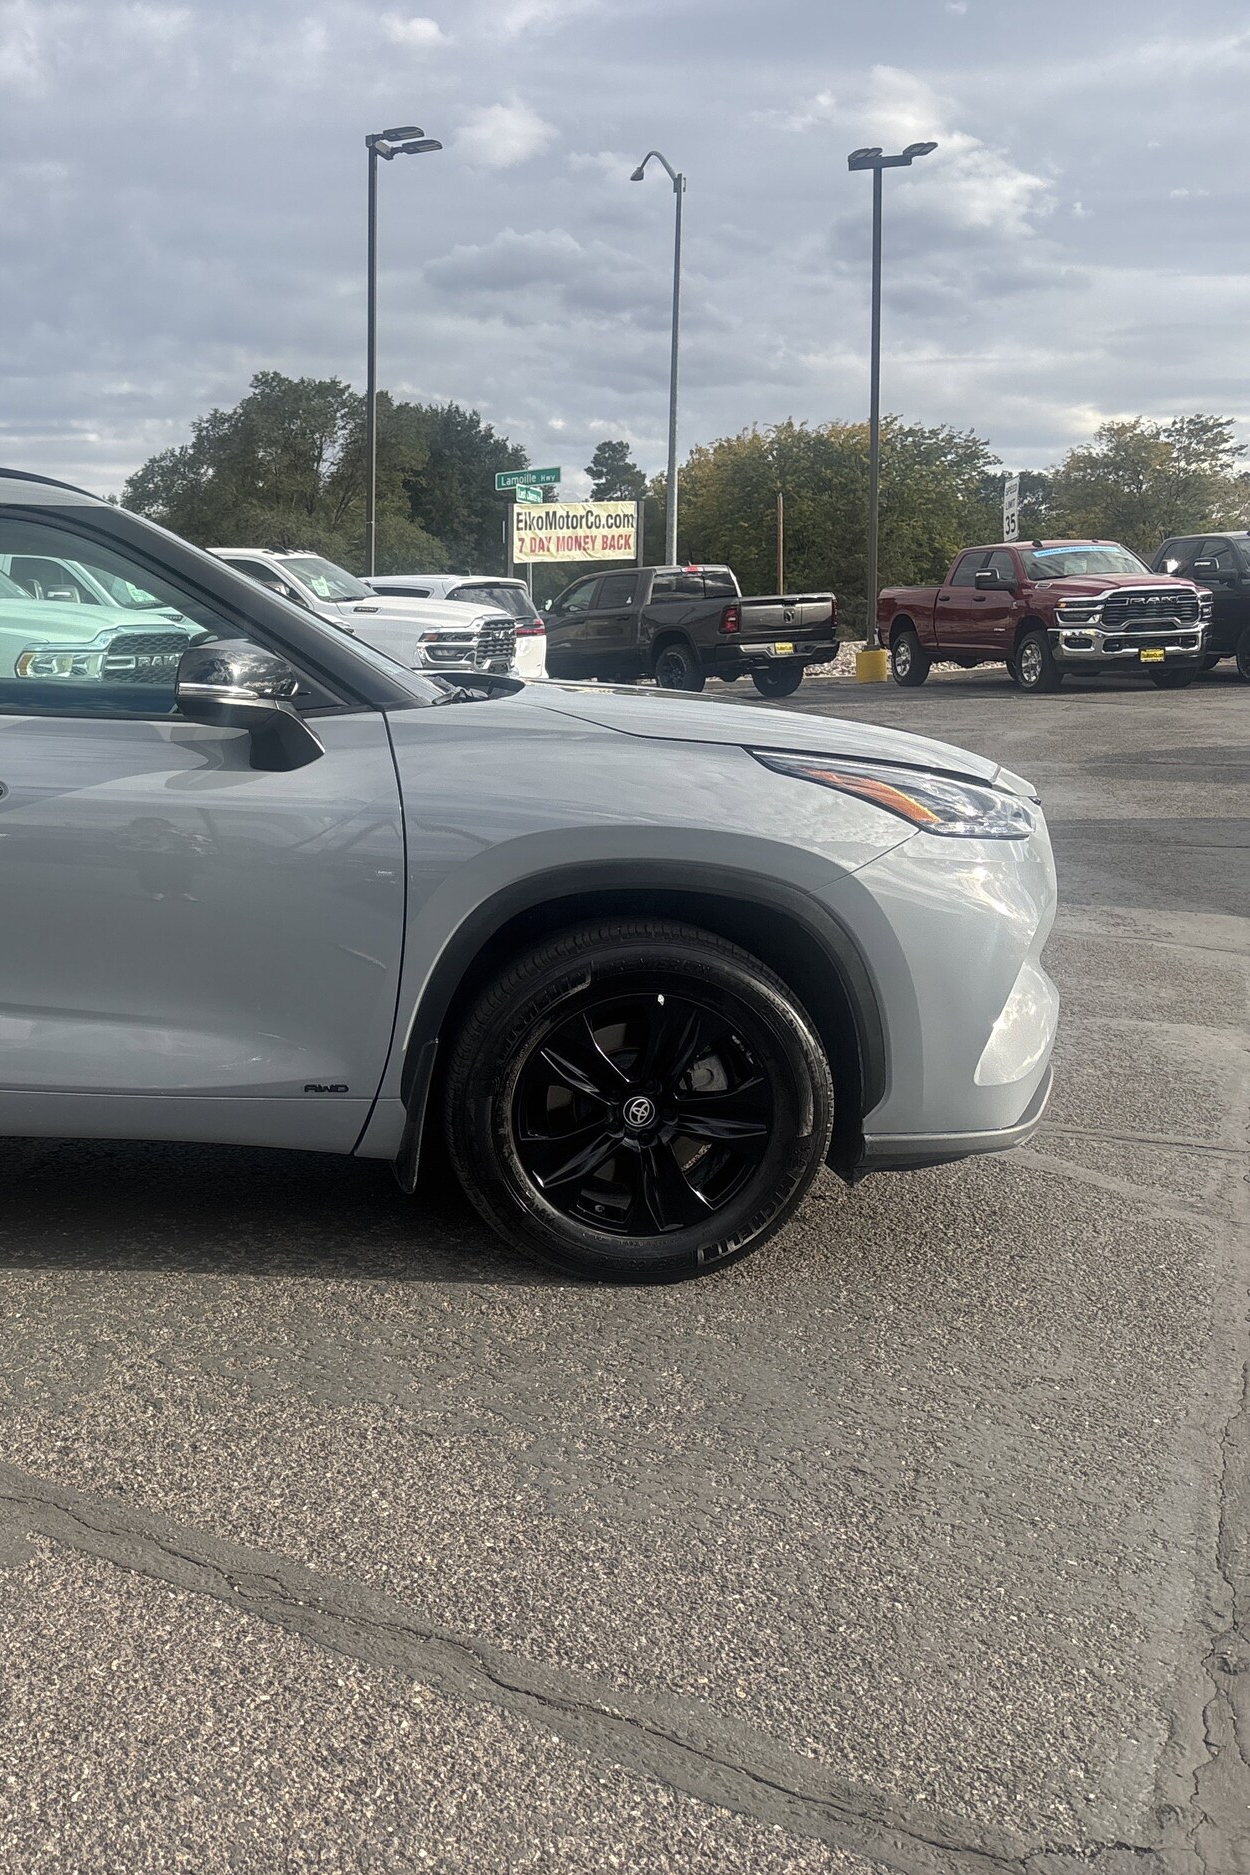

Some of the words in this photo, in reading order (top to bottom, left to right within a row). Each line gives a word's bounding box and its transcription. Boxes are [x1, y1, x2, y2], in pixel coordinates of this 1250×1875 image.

[501, 472, 537, 487] Lamoille
[540, 473, 556, 482] Hwy
[516, 510, 634, 531] ElkoMotorCo.com
[1005, 513, 1016, 535] 35
[518, 537, 525, 554] 7
[529, 536, 552, 553] DAY
[556, 534, 598, 553] MONEY
[601, 533, 632, 550] BACK
[1129, 596, 1177, 605] RAM
[137, 655, 179, 668] RAM
[304, 1083, 349, 1093] AWD
